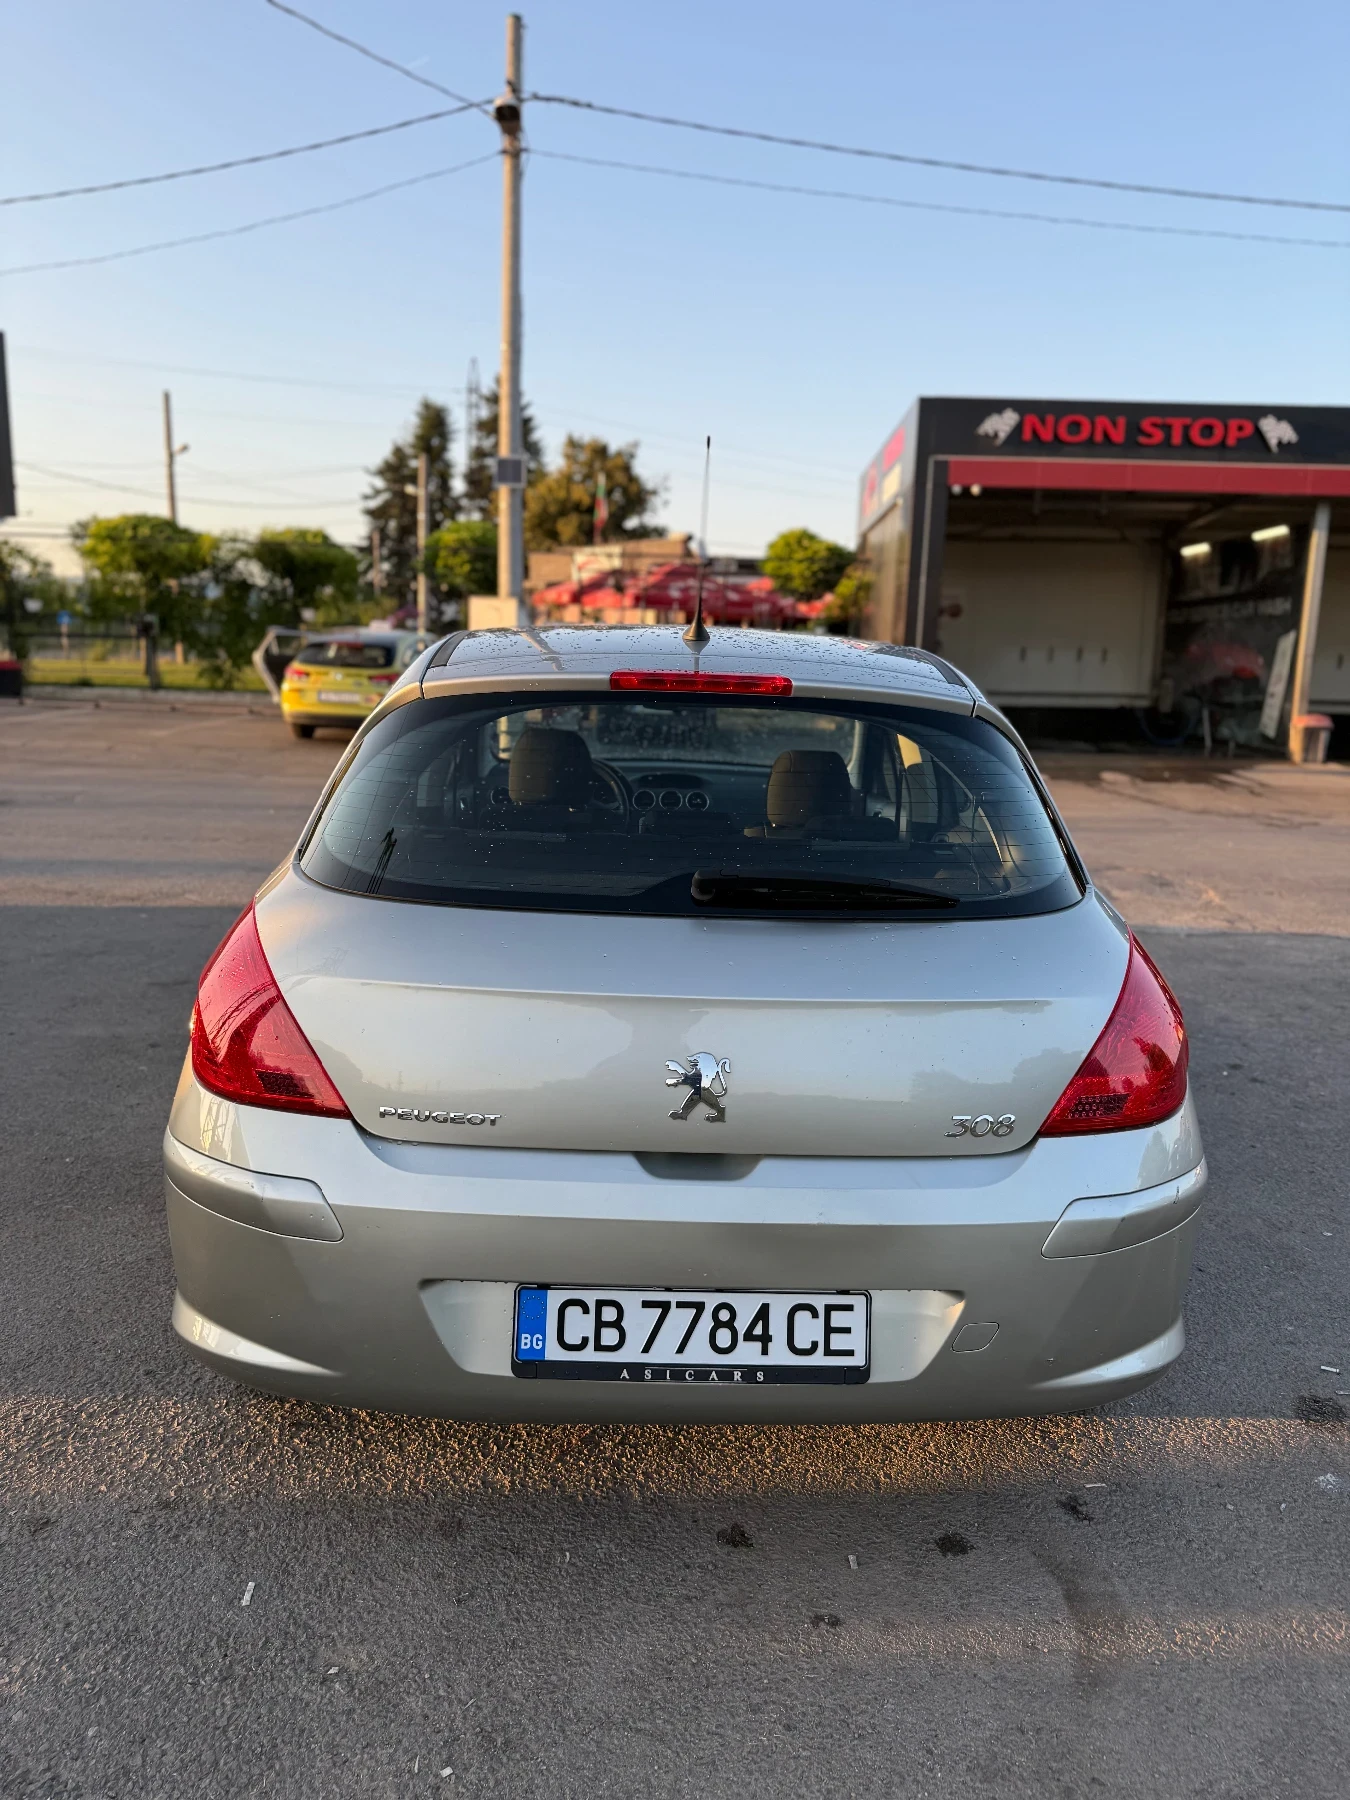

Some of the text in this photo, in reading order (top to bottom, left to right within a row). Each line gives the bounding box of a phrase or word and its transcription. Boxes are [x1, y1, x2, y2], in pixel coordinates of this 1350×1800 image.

[1021, 413, 1255, 448] NON STOP
[379, 1106, 502, 1127] PEUGEOT
[943, 1113, 1016, 1138] 308
[520, 1333, 544, 1350] BG
